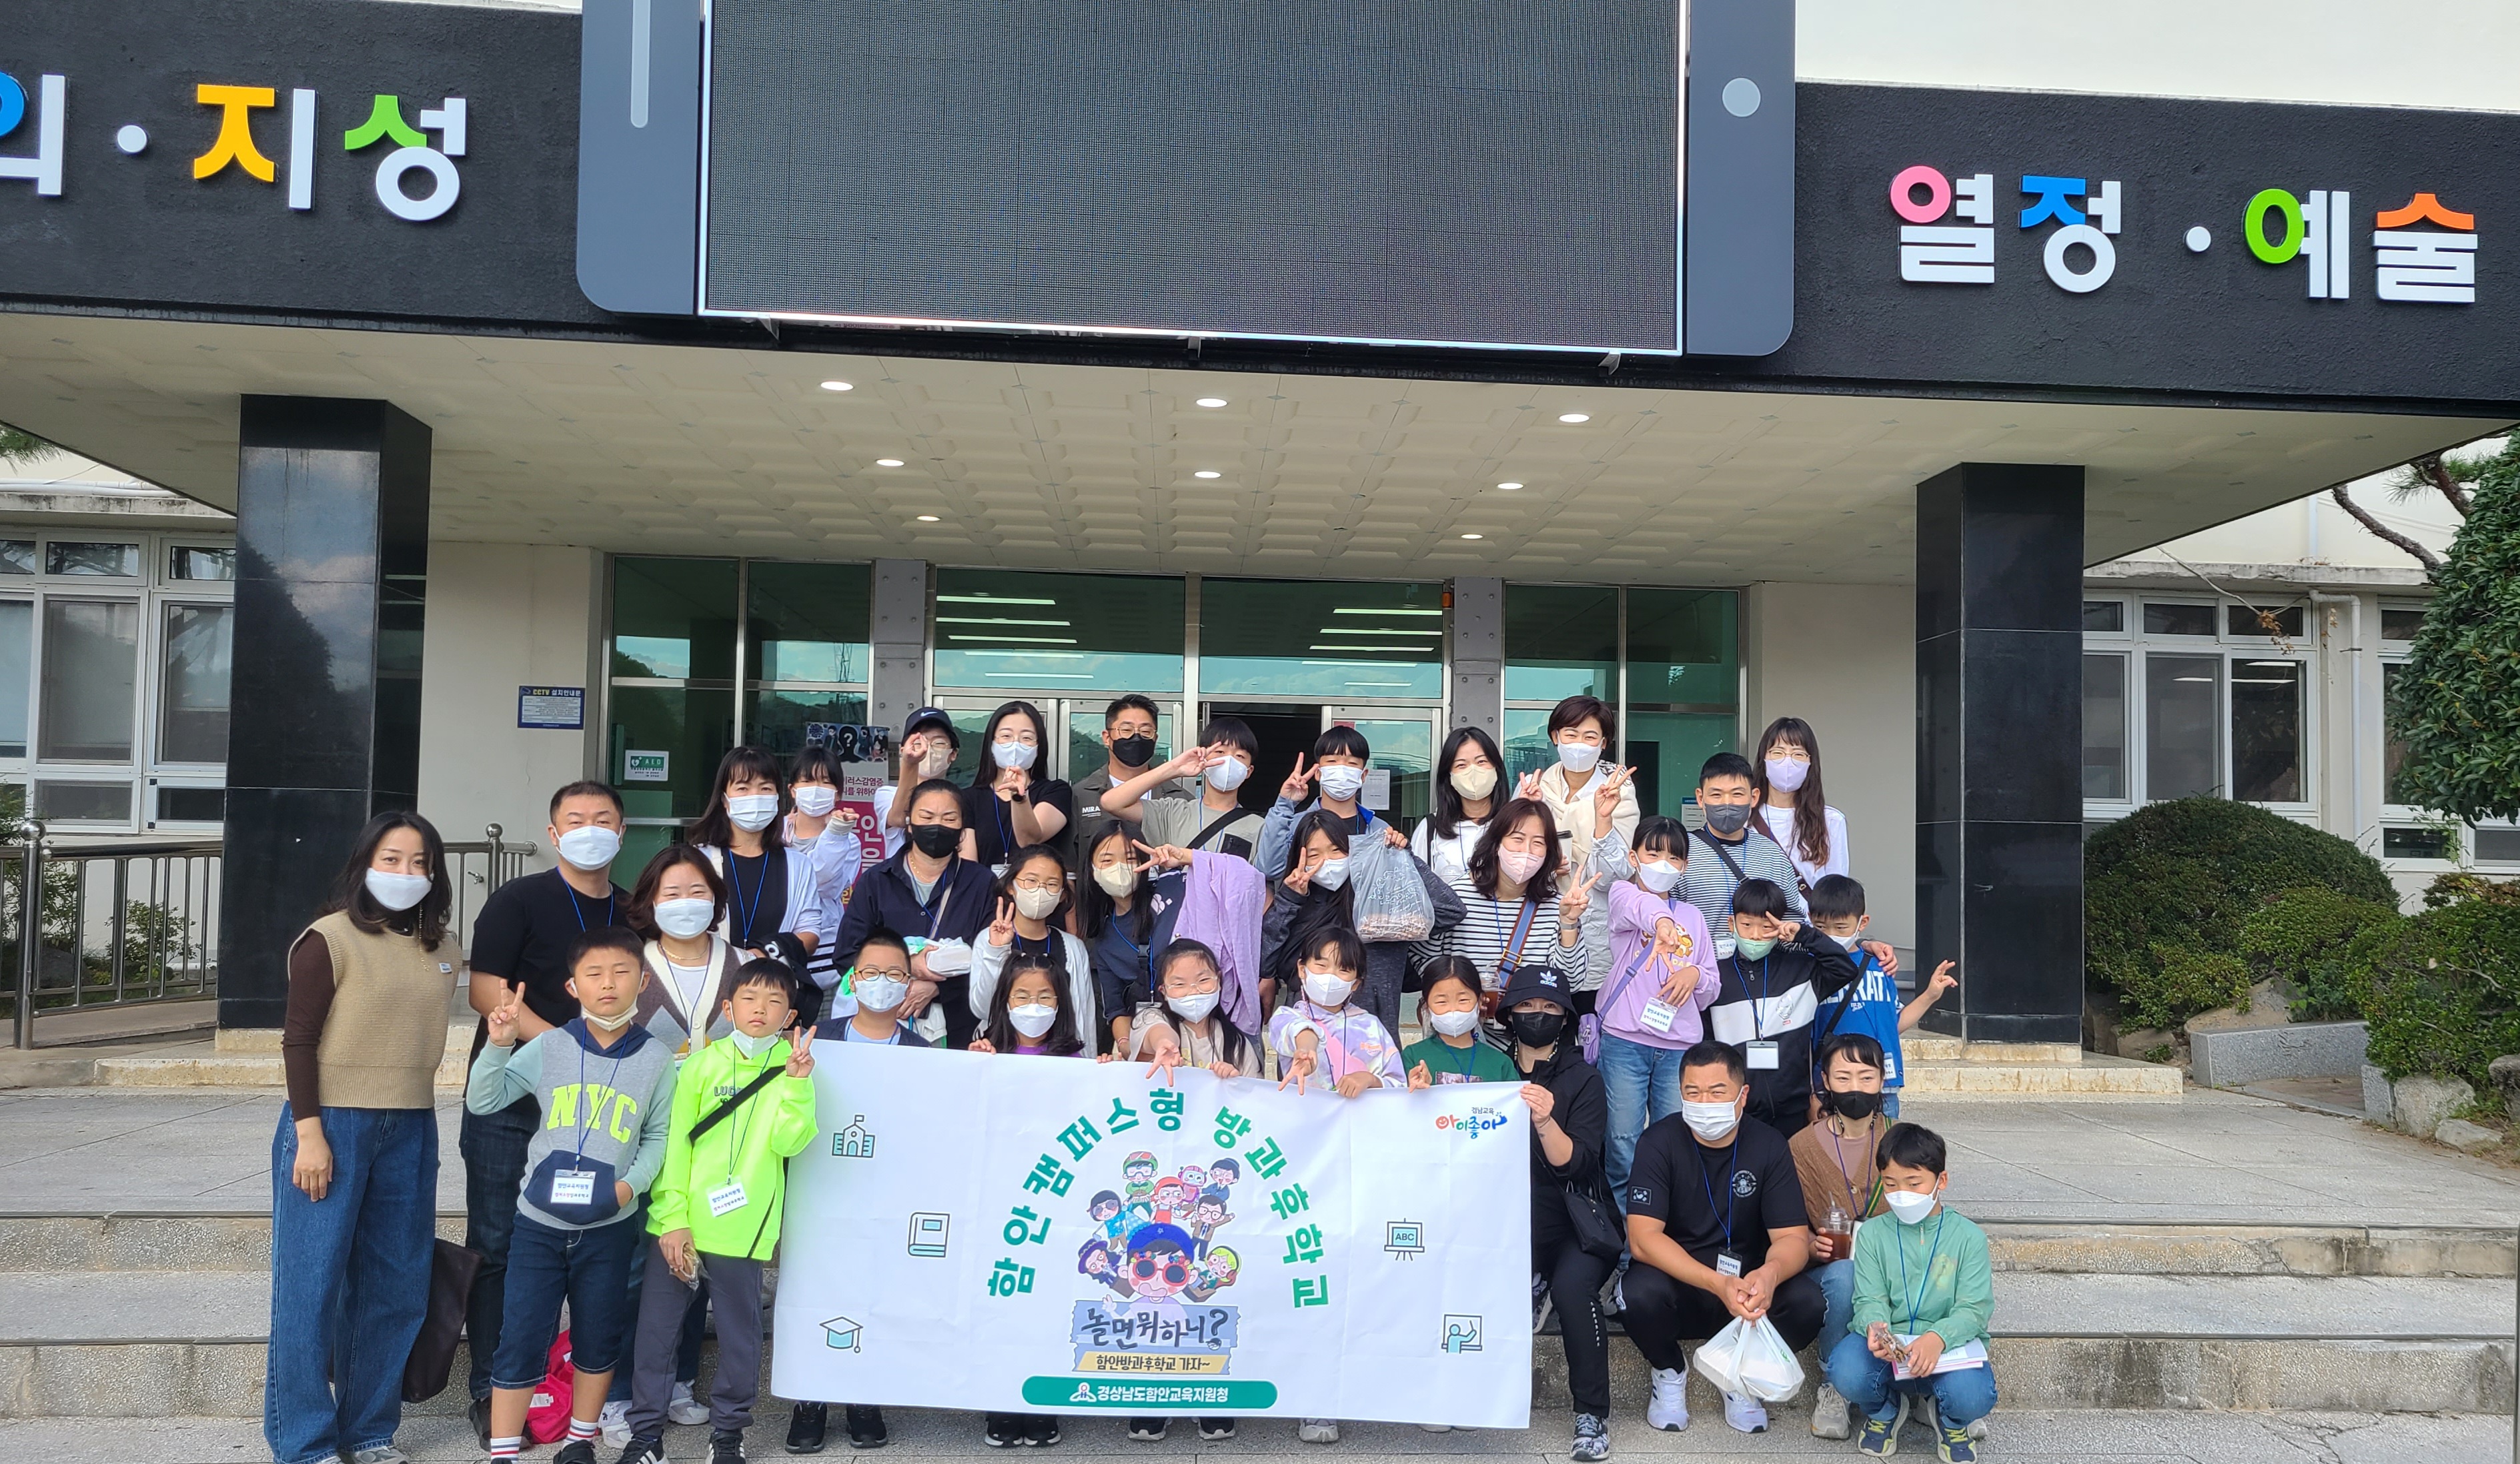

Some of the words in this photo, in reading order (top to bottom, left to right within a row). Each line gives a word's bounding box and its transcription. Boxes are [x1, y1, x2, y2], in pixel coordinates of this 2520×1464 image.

[193, 84, 466, 221] 지성
[1890, 165, 2122, 293] 열정
[2245, 189, 2478, 303] 예술
[546, 1083, 638, 1143] NYC
[1213, 1105, 1329, 1309] 방과후학교
[1395, 1233, 1414, 1241] ABC
[1096, 1355, 1176, 1371] 함안방과후학교
[1097, 1385, 1229, 1403] 경상남도함안교육지원청
